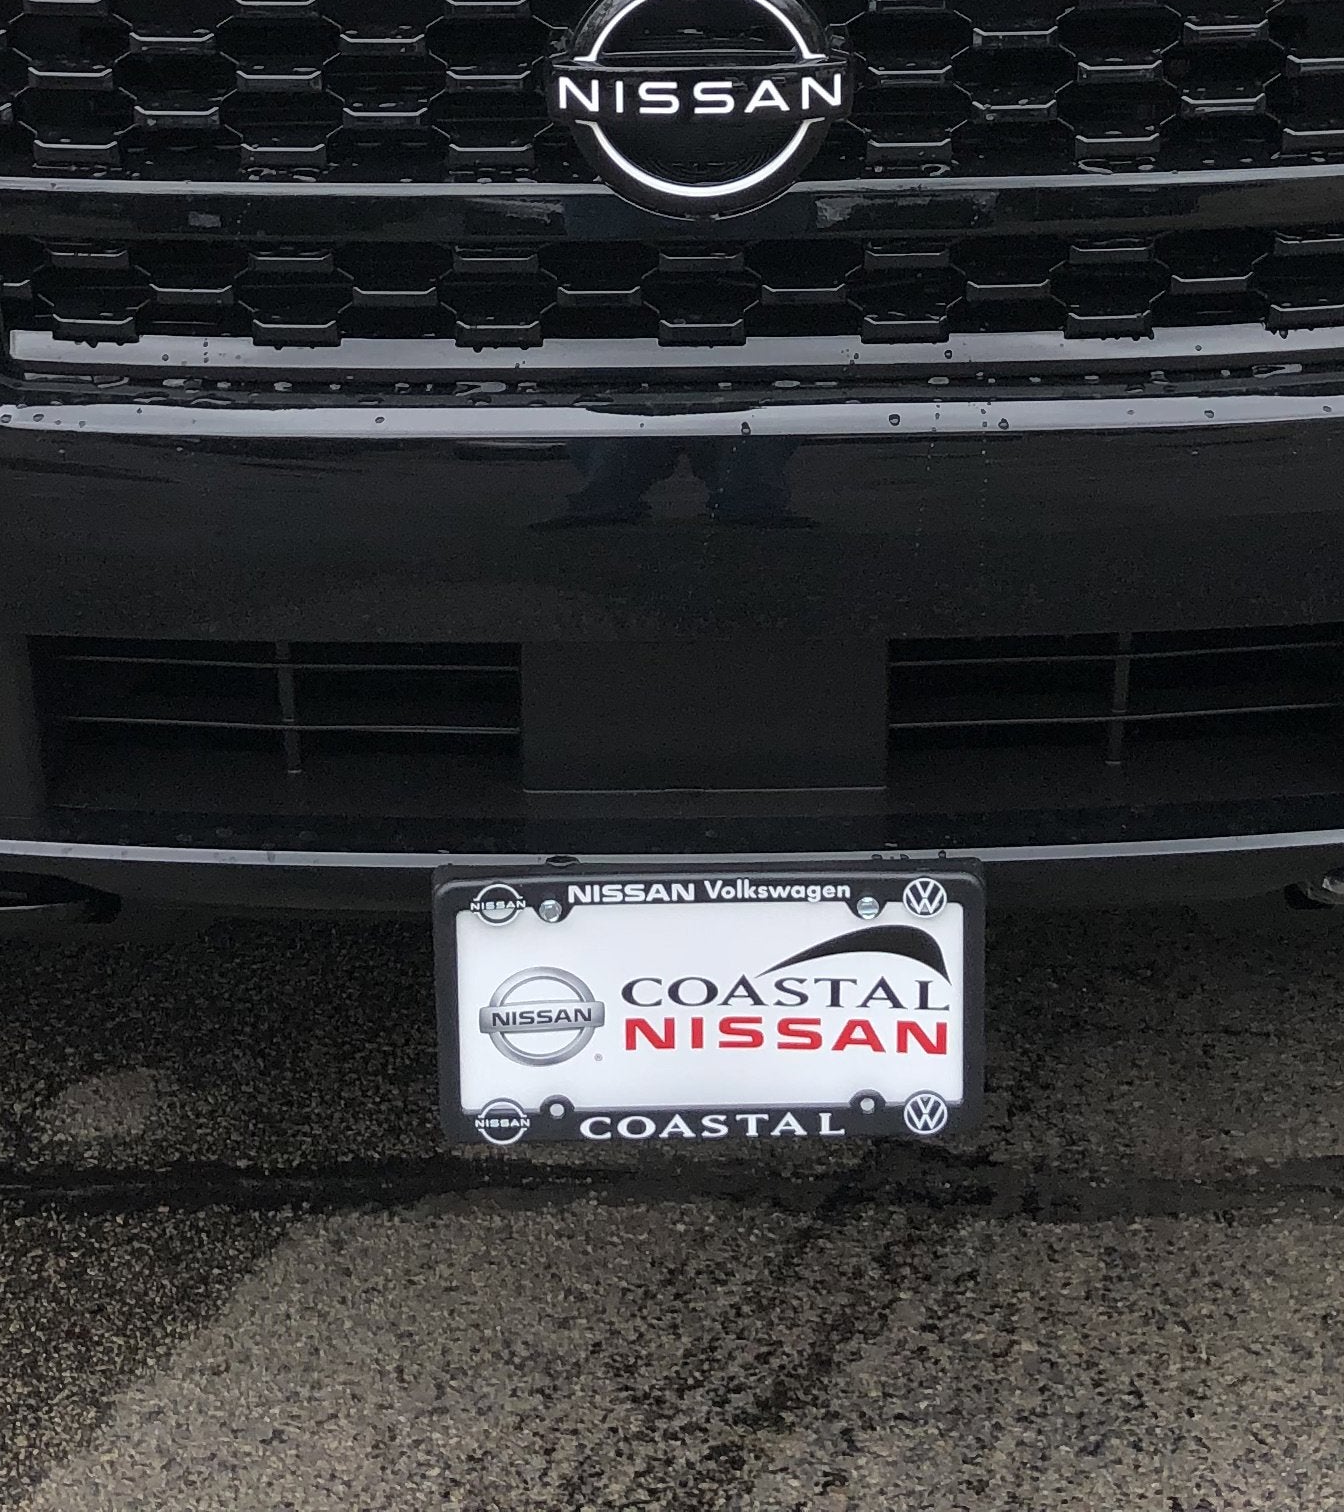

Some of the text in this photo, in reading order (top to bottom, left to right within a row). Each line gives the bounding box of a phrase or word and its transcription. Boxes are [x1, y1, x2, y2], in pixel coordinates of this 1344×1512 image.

[559, 73, 842, 115] NISSAN
[568, 879, 851, 904] NISSAN Volkswagen
[470, 899, 526, 912] NISSAN
[621, 974, 950, 1011] COASTAL
[492, 1007, 592, 1026] NISSAN
[625, 1016, 947, 1055] NISSAN
[475, 1116, 531, 1129] NISSAN
[579, 1113, 845, 1139] COASTAL
